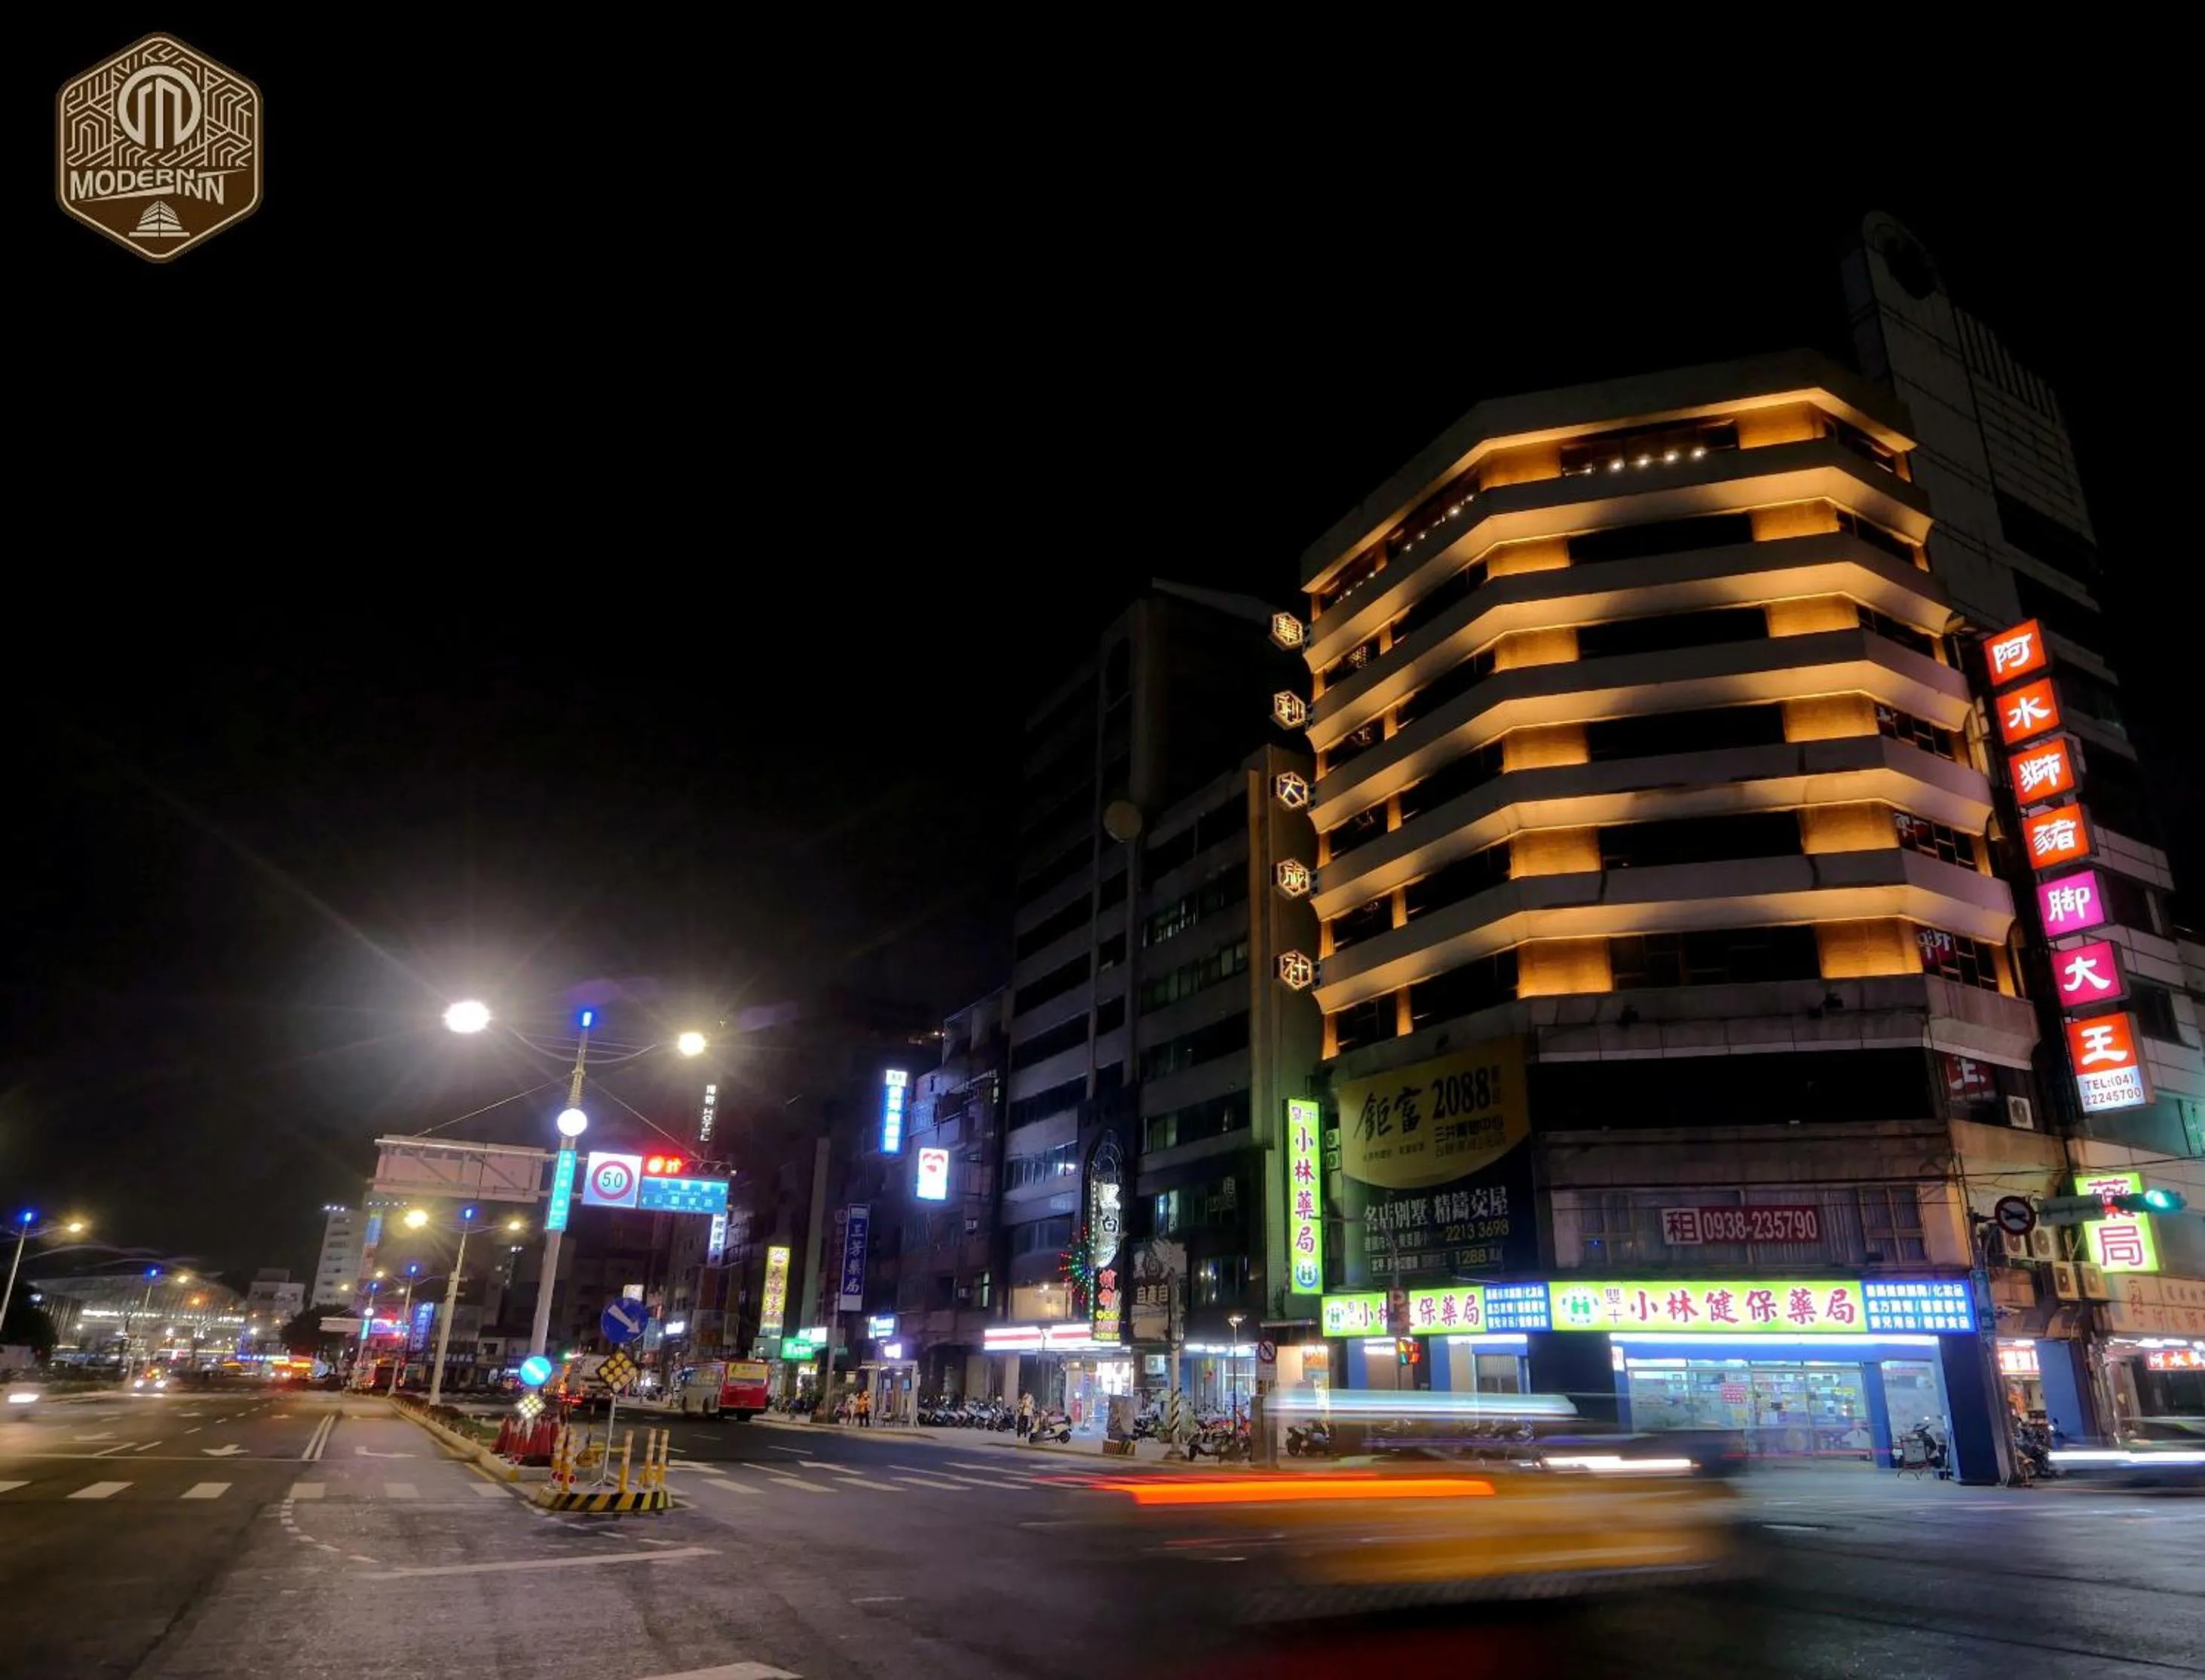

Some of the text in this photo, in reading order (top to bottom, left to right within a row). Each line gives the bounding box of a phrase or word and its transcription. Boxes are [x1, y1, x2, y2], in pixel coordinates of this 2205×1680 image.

[1432, 1066, 1492, 1120] 2088
[2084, 1088, 2142, 1106] 22245700
[602, 1171, 623, 1188] 50
[1294, 1127, 1315, 1253] 小林藥局
[1667, 1210, 1818, 1242] 租 0938-235790
[1359, 1294, 1480, 1328] 小林保藥局
[1630, 1288, 1854, 1324] 小林健保藥局
